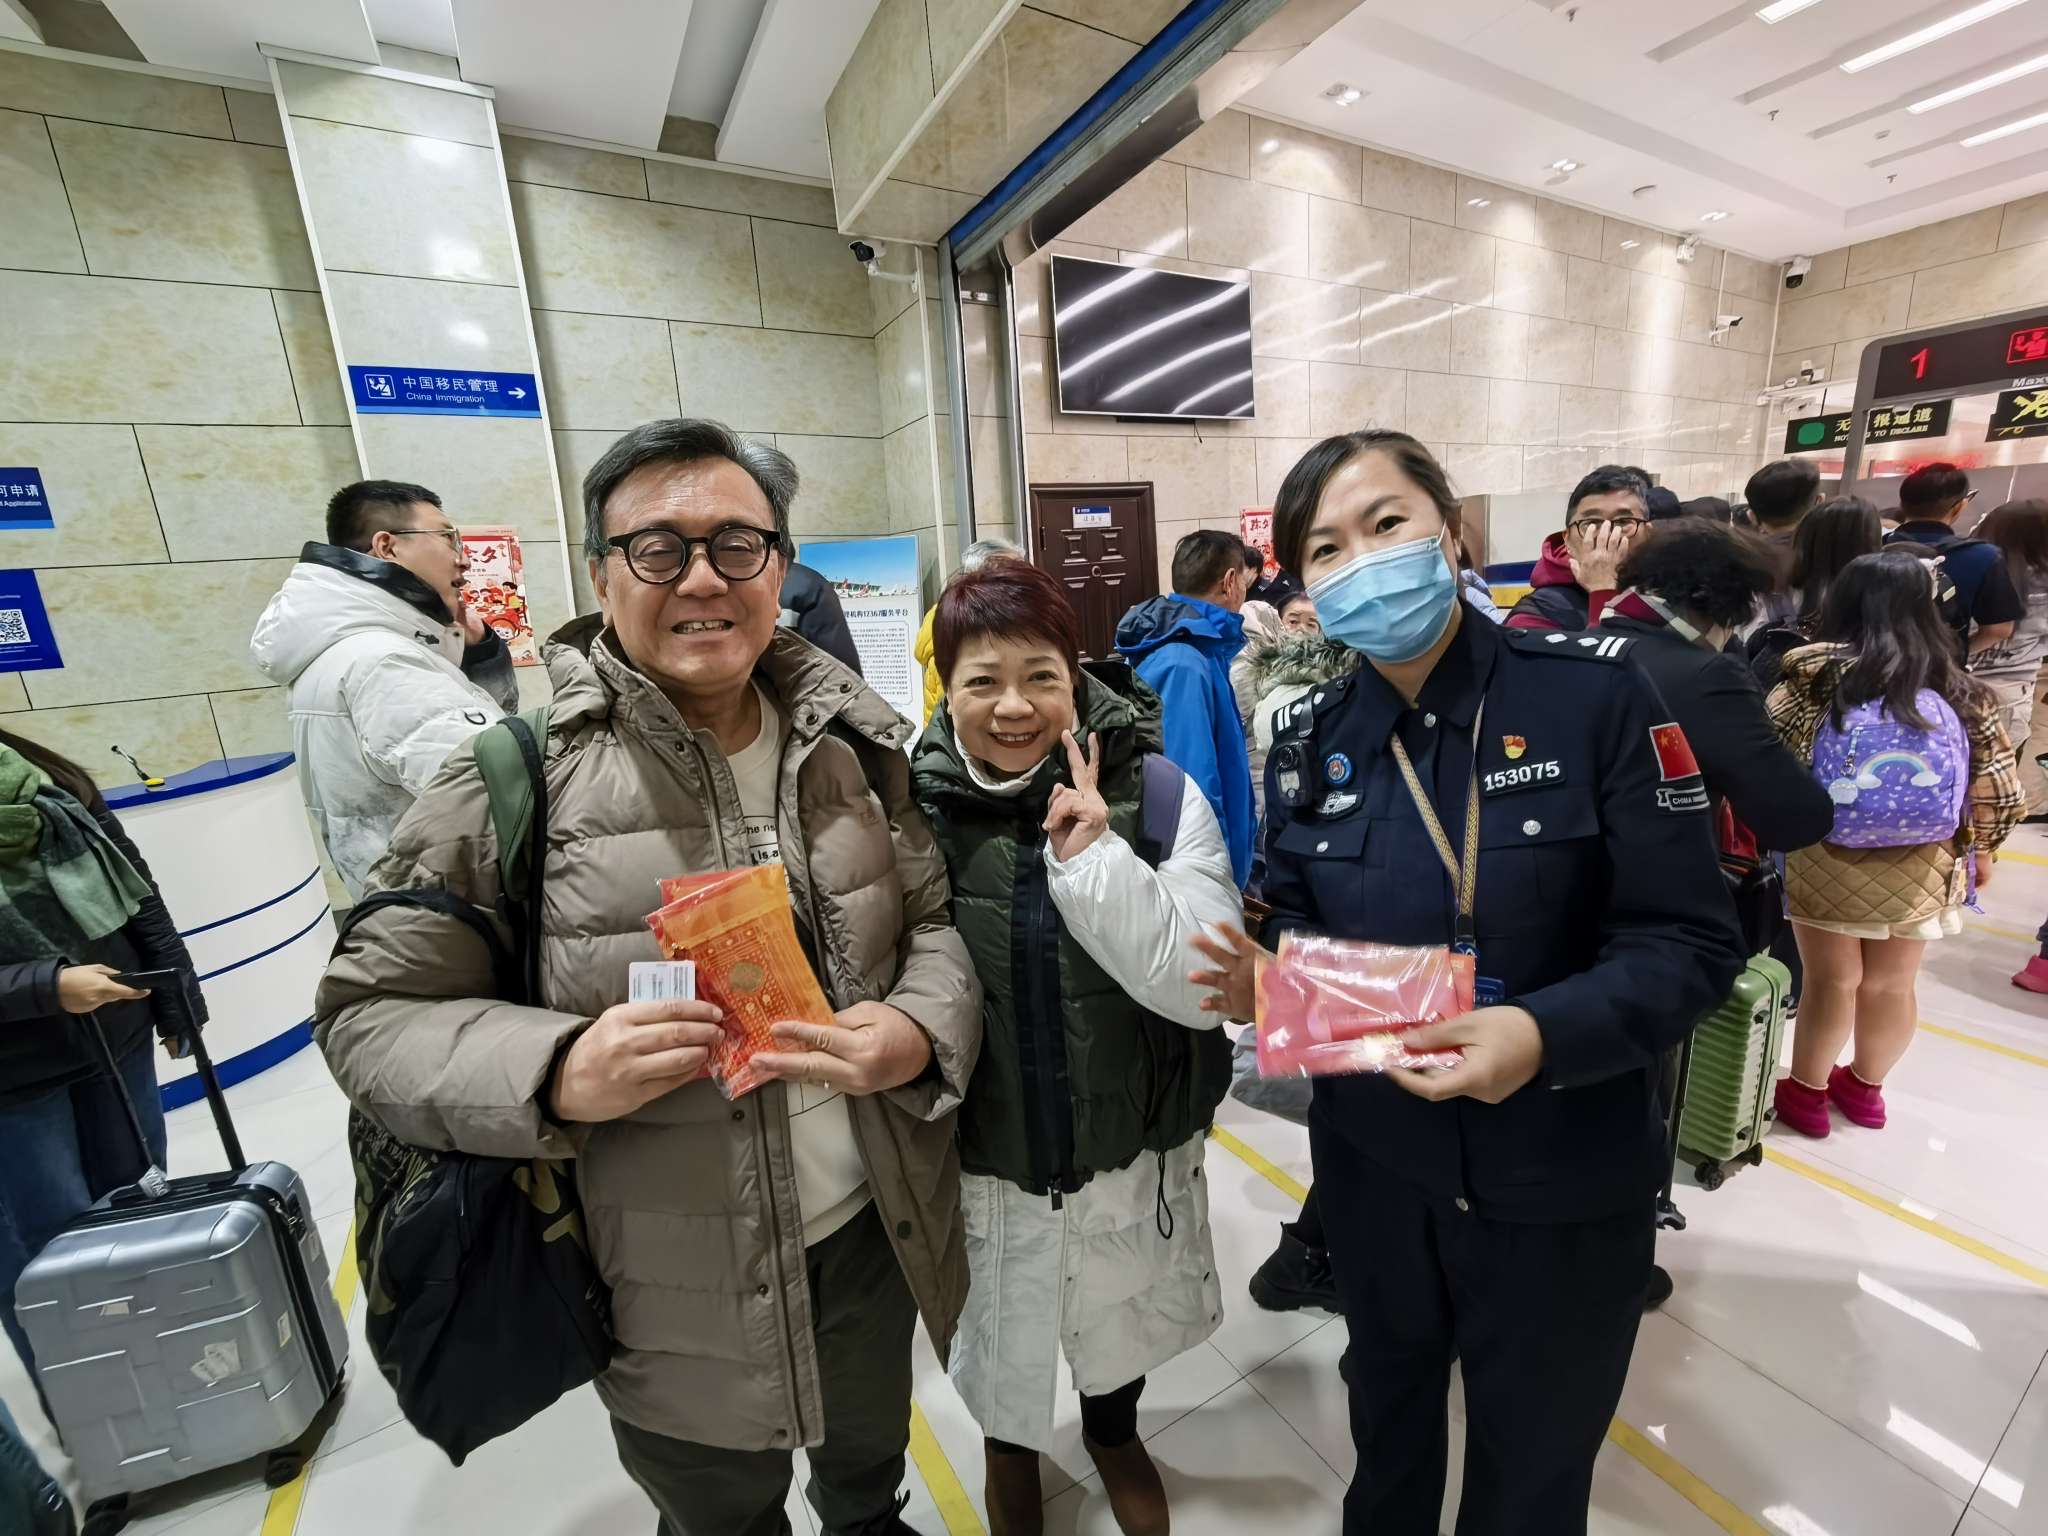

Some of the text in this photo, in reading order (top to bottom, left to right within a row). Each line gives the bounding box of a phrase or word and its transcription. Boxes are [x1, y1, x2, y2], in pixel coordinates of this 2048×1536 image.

[1910, 348, 1929, 379] 1
[402, 375, 500, 393] 中国移民管理
[406, 392, 485, 404] China Immigration
[1834, 407, 1933, 433] 无报通道
[1484, 760, 1560, 791] 153075
